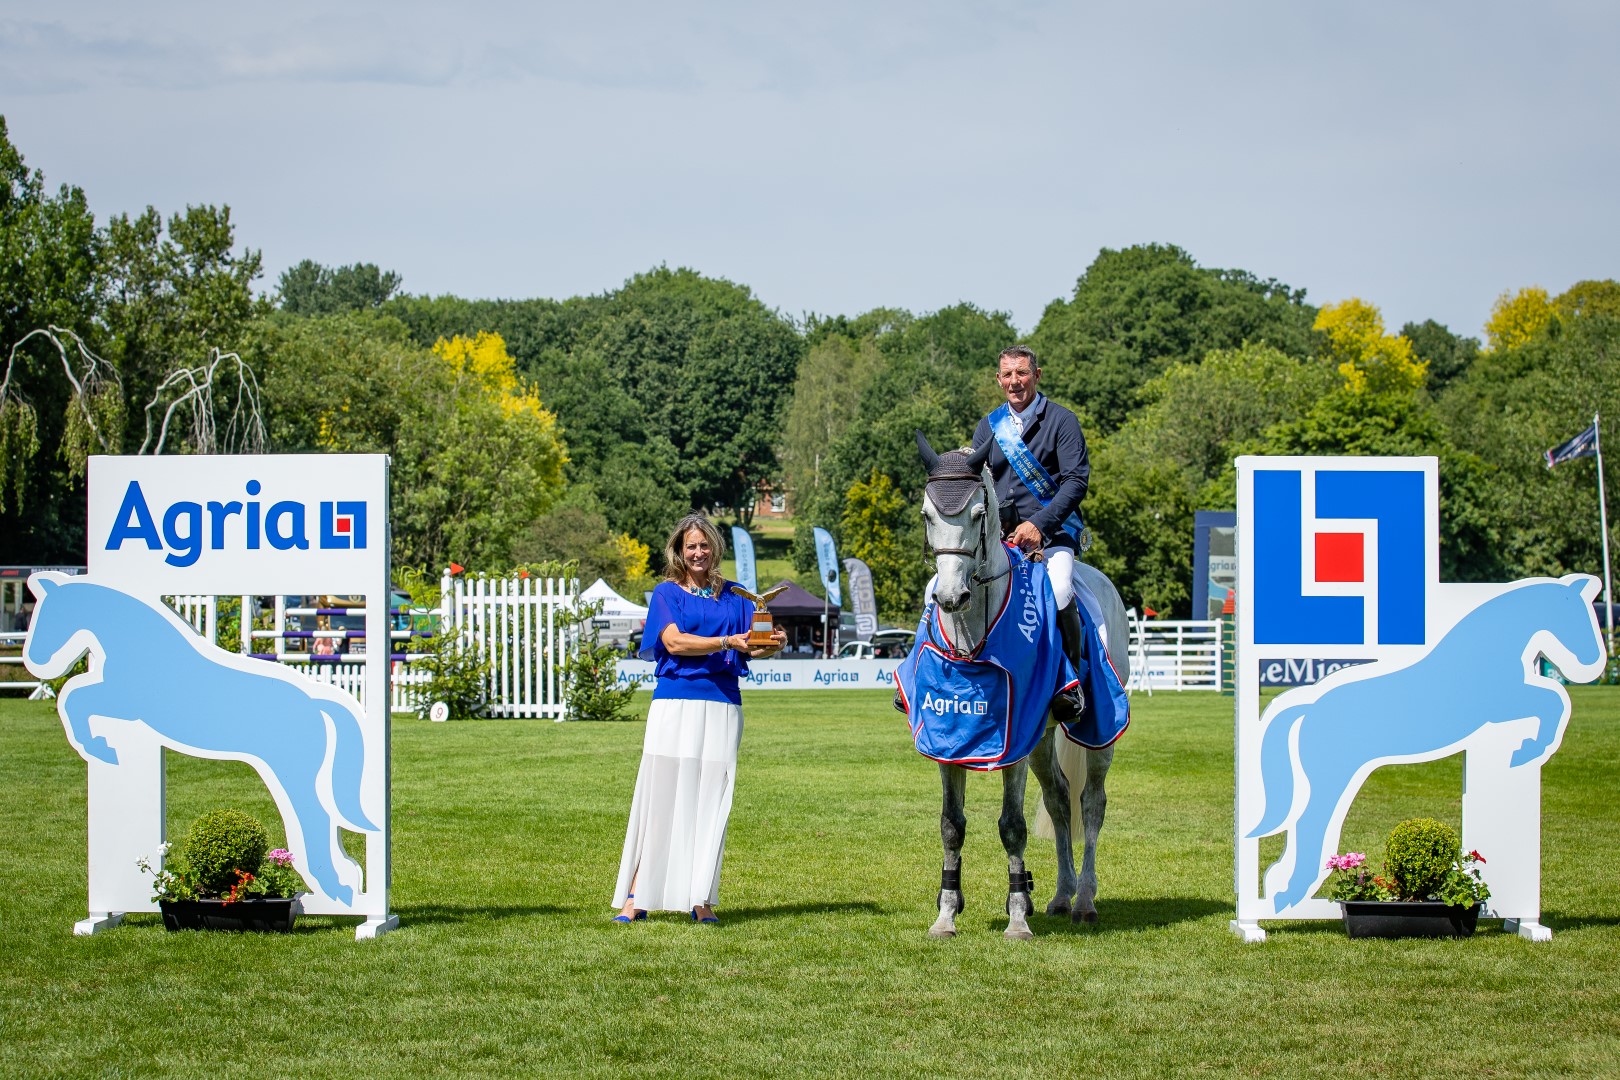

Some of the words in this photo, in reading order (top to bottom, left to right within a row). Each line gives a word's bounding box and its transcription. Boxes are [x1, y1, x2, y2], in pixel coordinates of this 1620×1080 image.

[1016, 460, 1034, 480] DERBY
[1031, 479, 1047, 498] TRIAL
[104, 479, 309, 568] Agria
[1210, 559, 1230, 573] gria
[746, 669, 781, 685] Agria
[813, 669, 848, 685] Agria
[922, 691, 972, 716] Agria
[436, 707, 443, 719] 9
